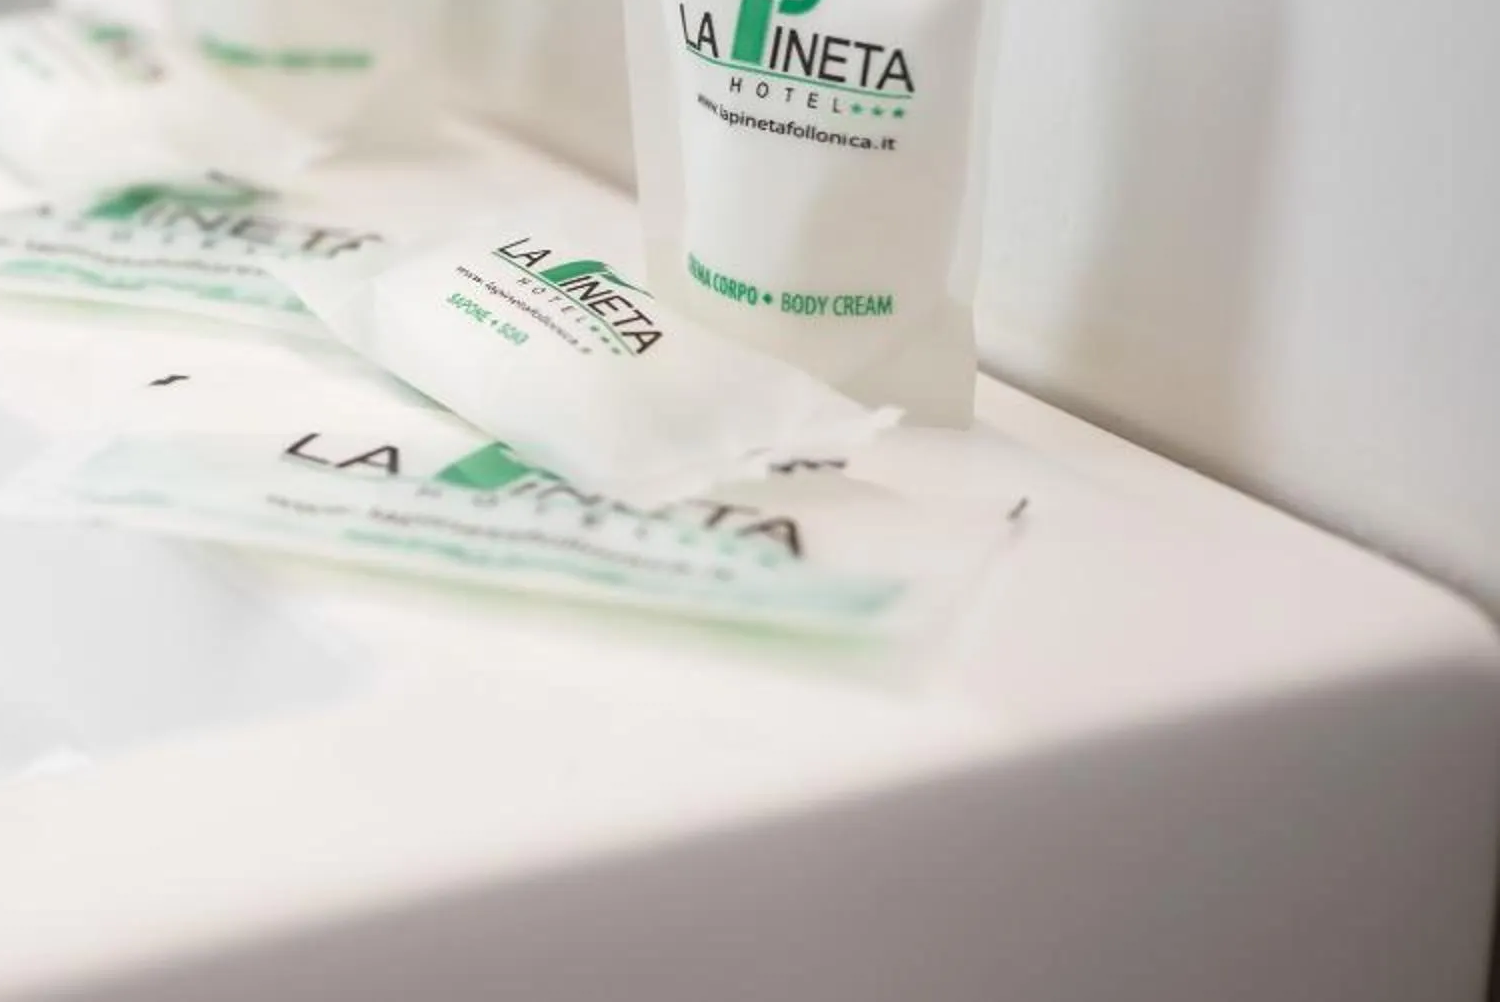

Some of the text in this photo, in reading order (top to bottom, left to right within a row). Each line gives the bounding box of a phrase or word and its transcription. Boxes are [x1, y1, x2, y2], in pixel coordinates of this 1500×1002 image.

[679, 3, 719, 59] LA
[729, 75, 843, 114] HOTEL
[498, 236, 663, 355] LA PINETA
[713, 273, 758, 306] CORPO
[780, 291, 829, 316] BODY
[832, 294, 894, 317] CREAM
[285, 433, 399, 476] LA
